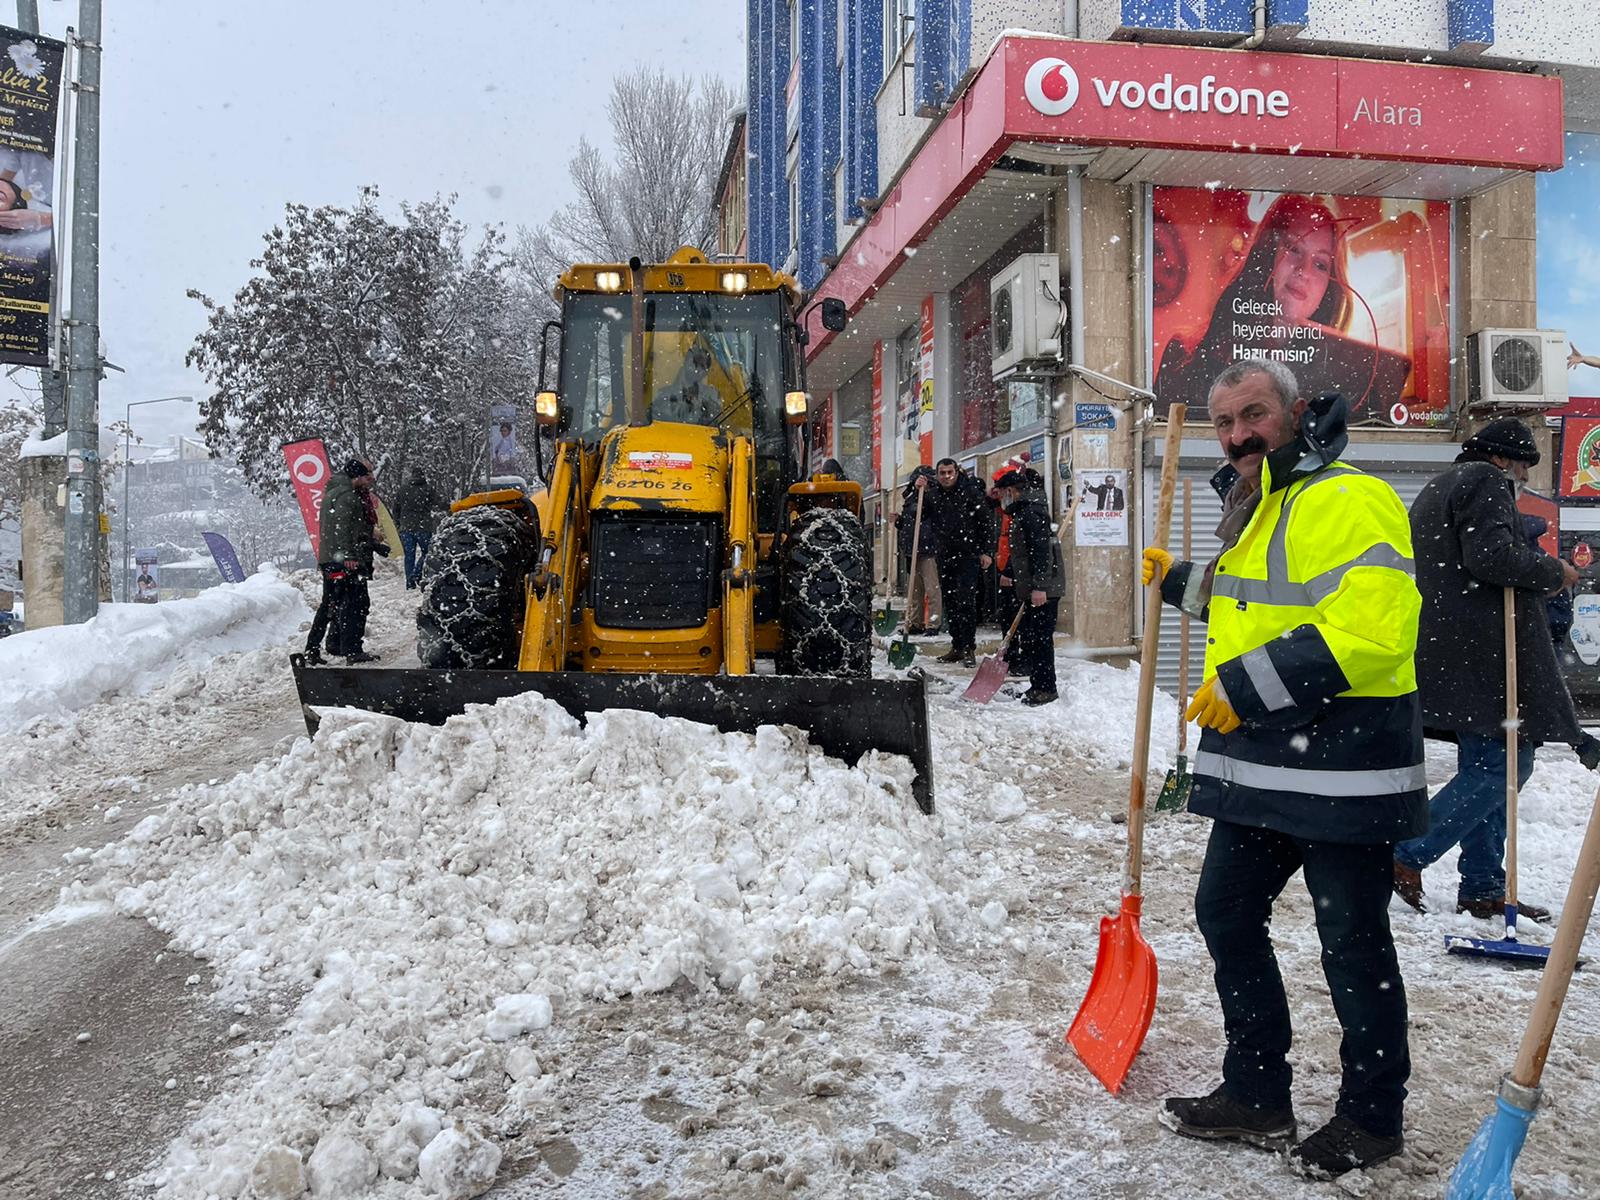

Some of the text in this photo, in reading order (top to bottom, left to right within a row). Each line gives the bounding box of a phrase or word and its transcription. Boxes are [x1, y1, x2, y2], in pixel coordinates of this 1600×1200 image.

[1094, 73, 1422, 126] vodafone Alara
[1232, 297, 1283, 316] Gelecek
[1232, 320, 1325, 341] heyecan verici.
[1233, 344, 1315, 362] Hazır mısın?
[671, 481, 692, 491] 26
